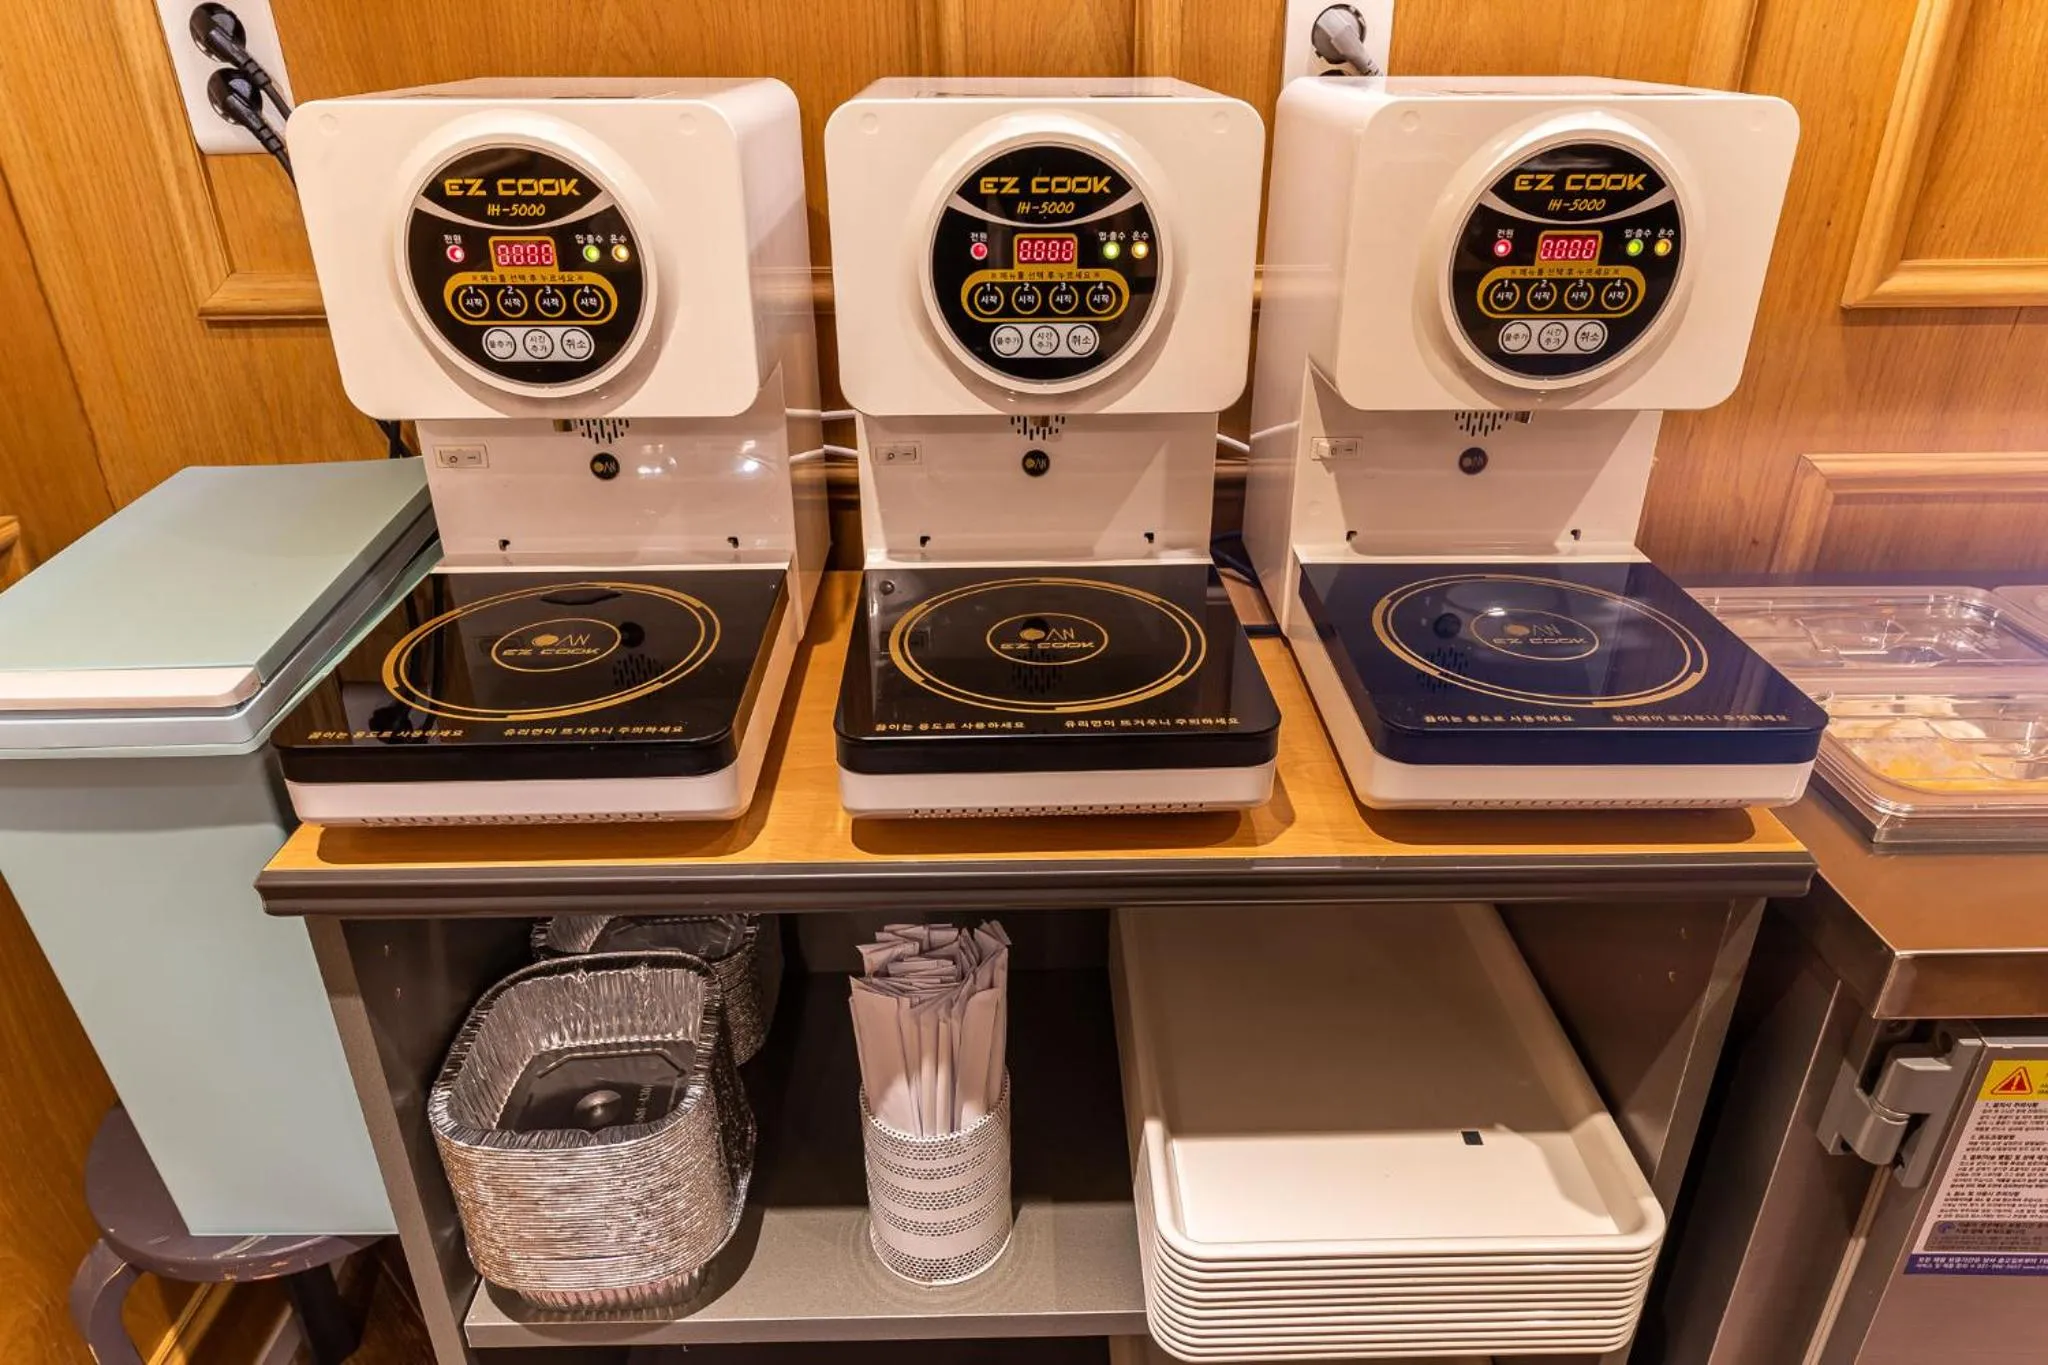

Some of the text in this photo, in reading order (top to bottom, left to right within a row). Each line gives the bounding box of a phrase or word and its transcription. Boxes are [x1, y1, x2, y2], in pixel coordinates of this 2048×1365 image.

[444, 178, 581, 196] EZ COOK
[980, 176, 1112, 194] EZ COOK
[1514, 174, 1647, 191] EZ COOK
[1017, 202, 1075, 214] IH-5000
[1548, 199, 1606, 211] IH-5000
[487, 204, 546, 217] IH-5000
[981, 295, 998, 304] 시작
[1018, 295, 1035, 304] 시작
[1055, 294, 1072, 304] 시작
[1092, 294, 1109, 304] 시작
[1496, 291, 1514, 300] 시작
[1533, 291, 1551, 300] 시작
[1570, 291, 1588, 300] 시작
[1607, 290, 1625, 300] 시작
[465, 298, 483, 308] 시작
[504, 298, 521, 308] 시작
[542, 298, 559, 308] 시작
[580, 298, 598, 308] 시작
[1071, 335, 1091, 345] 취소
[1580, 332, 1600, 342] 취소
[565, 338, 587, 350] 취소
